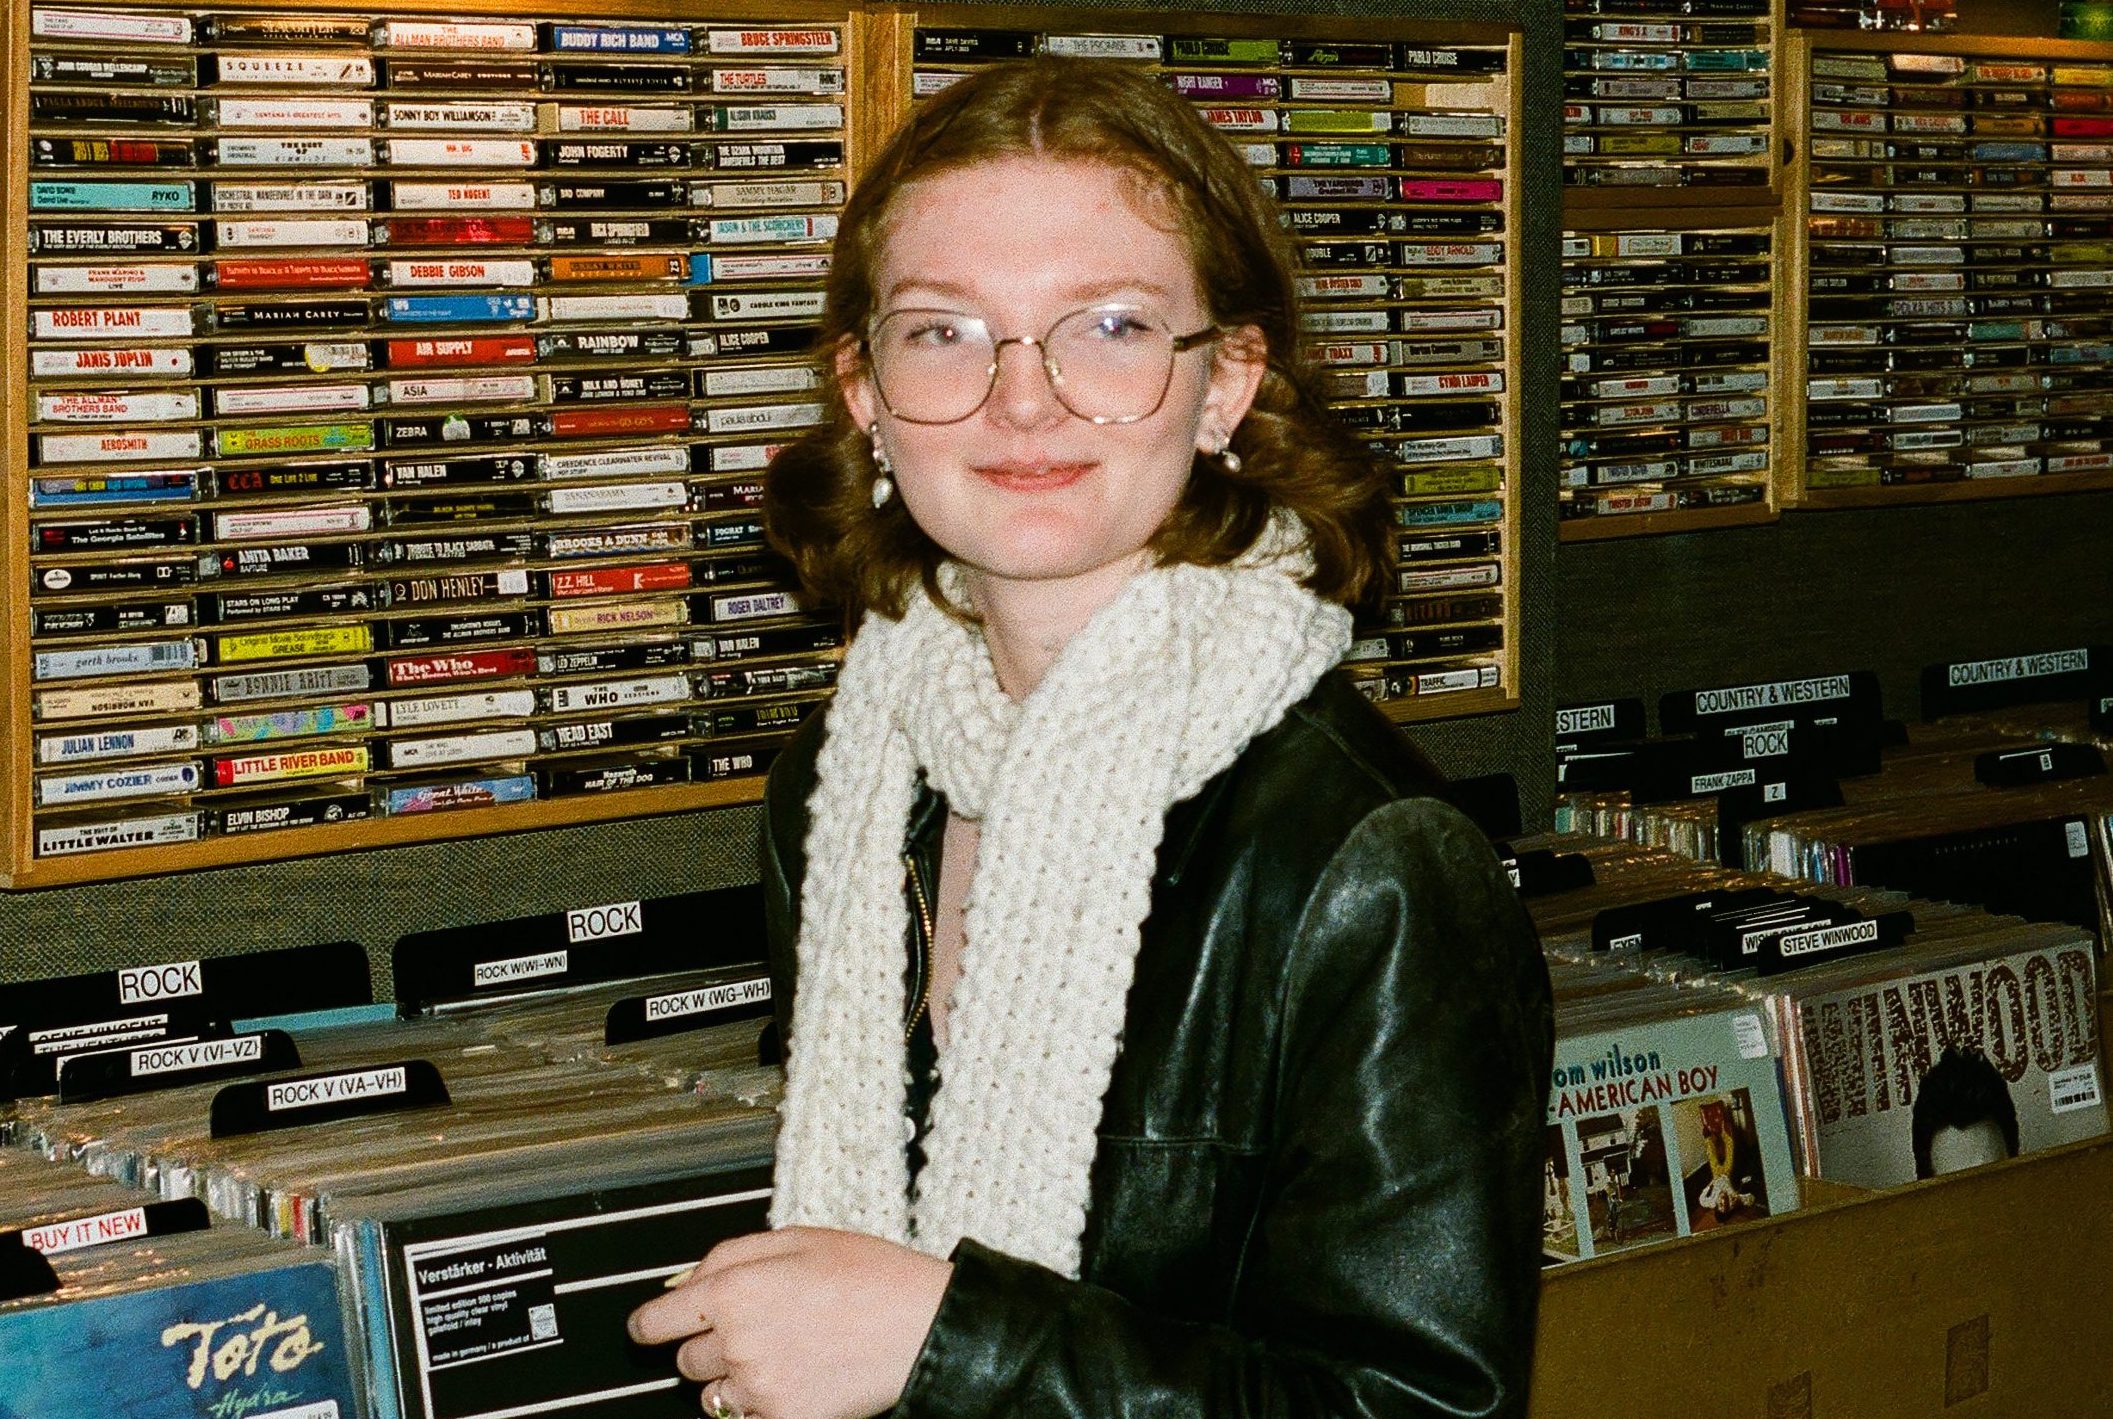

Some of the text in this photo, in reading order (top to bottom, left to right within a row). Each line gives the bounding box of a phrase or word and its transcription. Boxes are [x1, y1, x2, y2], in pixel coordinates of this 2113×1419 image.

[395, 34, 435, 48] ALLMAN
[436, 34, 482, 48] BROTHERS
[560, 33, 659, 48] BUDDY RICH BAND
[740, 32, 832, 46] BRUCE SPRINGSTEEN
[225, 60, 304, 72] SQUEEZE
[720, 73, 767, 85] THE TURTLES
[393, 109, 492, 122] SONNY BOY WILLIAMSON
[579, 110, 630, 126] THE CALL
[558, 145, 628, 158] JOHN FOGERTY
[151, 191, 180, 202] RYKO
[448, 188, 462, 200] TED
[43, 229, 162, 244] THE EVERLY BROTHERS
[410, 265, 485, 278] DEBBIE GIBSON
[53, 310, 141, 327] ROBERT PLANT
[254, 310, 340, 320] MARIAH CAREY
[415, 340, 473, 356] AIR SUPPLY
[577, 335, 639, 349] RAINBOW
[76, 351, 153, 368] JANIS JOPLIN
[60, 394, 117, 404] THE ALLMAN
[403, 386, 428, 396] ASIA
[52, 404, 128, 414] BROTHERS BAND
[395, 427, 428, 438] ZEBRA
[101, 438, 149, 451] AEROSMITH
[245, 435, 320, 450] GRASS ROOTS
[556, 458, 597, 468] CREEDENCE
[598, 455, 640, 466] CLEARWATER
[238, 546, 311, 565] ANITA BAKER
[410, 575, 485, 601] DON HENLEY
[75, 651, 140, 669] garth brooks
[392, 657, 475, 676] The Who
[1951, 650, 2087, 685] COUNTRY & WESTERN
[584, 692, 619, 706] WHO
[1697, 676, 1849, 712] COUNTRY & WESTERN
[395, 698, 461, 715] LYLE LOVETT
[555, 722, 613, 744] HEAD EAST
[61, 733, 135, 755] JULIAN LENNON
[1745, 732, 1788, 756] ROCK
[233, 750, 355, 775] LITTLE RIVER BAND
[712, 755, 753, 772] THE WHO
[63, 774, 152, 794] JIMMY COZIER
[1694, 770, 1754, 791] FRANK ZAPPA
[227, 807, 290, 826] ELVIN BISHOP
[42, 831, 154, 852] LITTLE WALTER
[570, 904, 640, 940] ROCK
[1783, 932, 1820, 953] STEVE
[1820, 923, 1876, 948] WINWOOD
[476, 966, 508, 982] ROCK
[121, 965, 200, 1001] ROCK
[649, 999, 688, 1017] ROCK
[692, 995, 705, 1009] W
[138, 1050, 184, 1070] ROCK
[189, 1047, 200, 1063] V
[1553, 1042, 1662, 1089] om wilson
[1677, 1064, 1718, 1096] BOY
[272, 1083, 319, 1107] ROCK
[323, 1081, 334, 1098] V
[31, 1215, 141, 1251] BUY IT NEW
[160, 1302, 325, 1390] Toto
